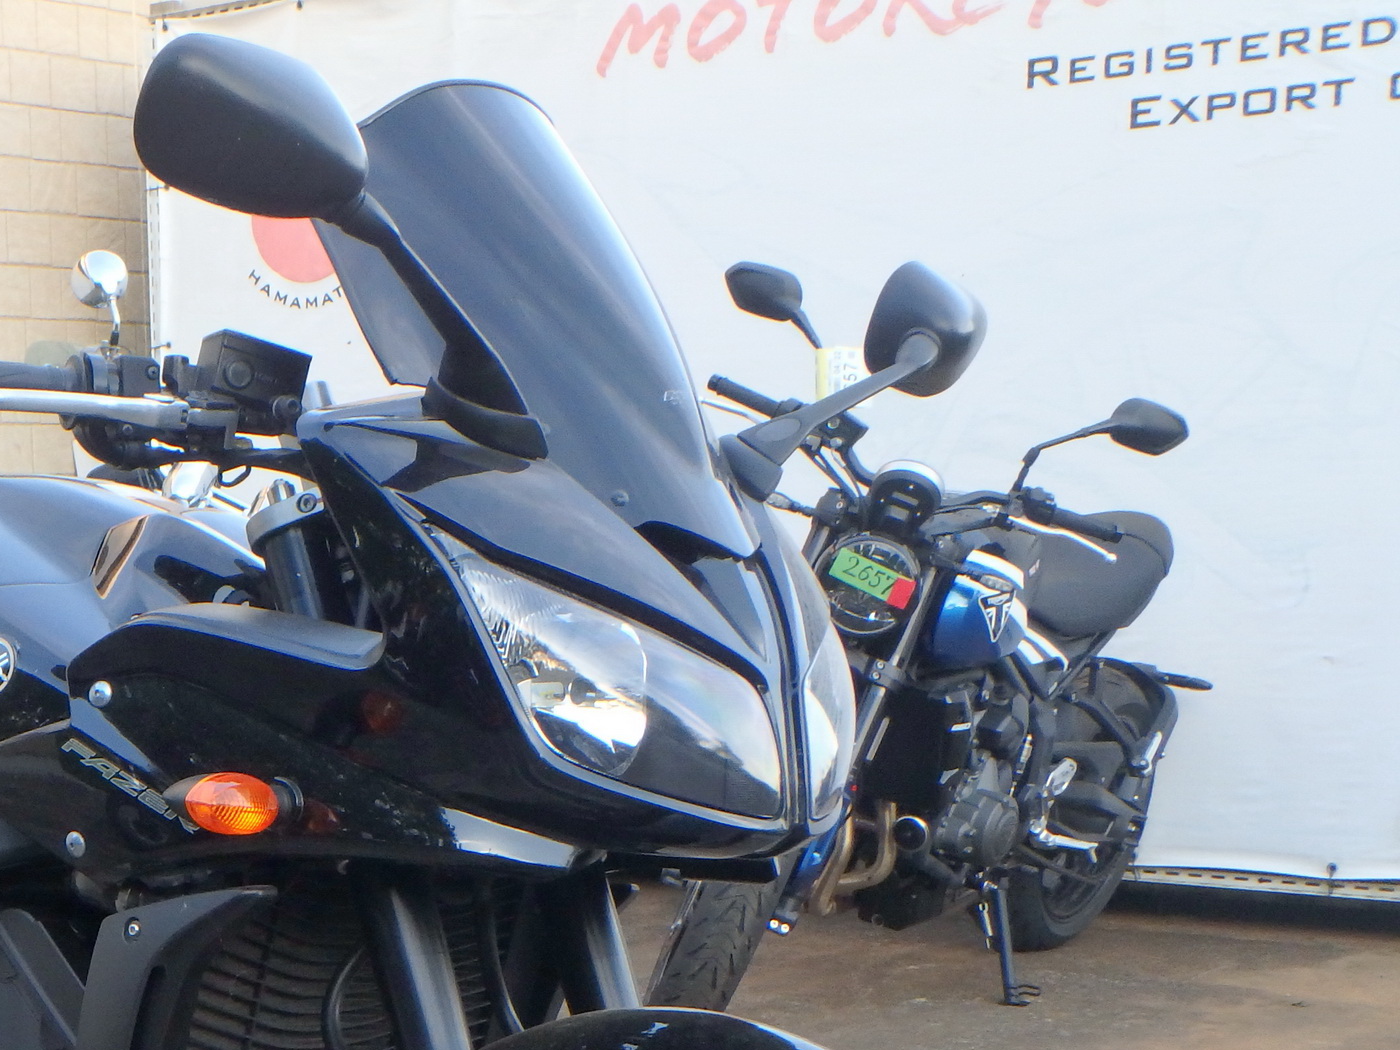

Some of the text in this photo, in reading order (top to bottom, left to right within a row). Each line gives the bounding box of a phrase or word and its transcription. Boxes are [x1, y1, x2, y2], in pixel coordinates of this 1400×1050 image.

[1026, 16, 1399, 89] REGISTERED
[1129, 78, 1355, 129] EXPORT
[842, 363, 858, 389] 57
[842, 556, 897, 596] 2657
